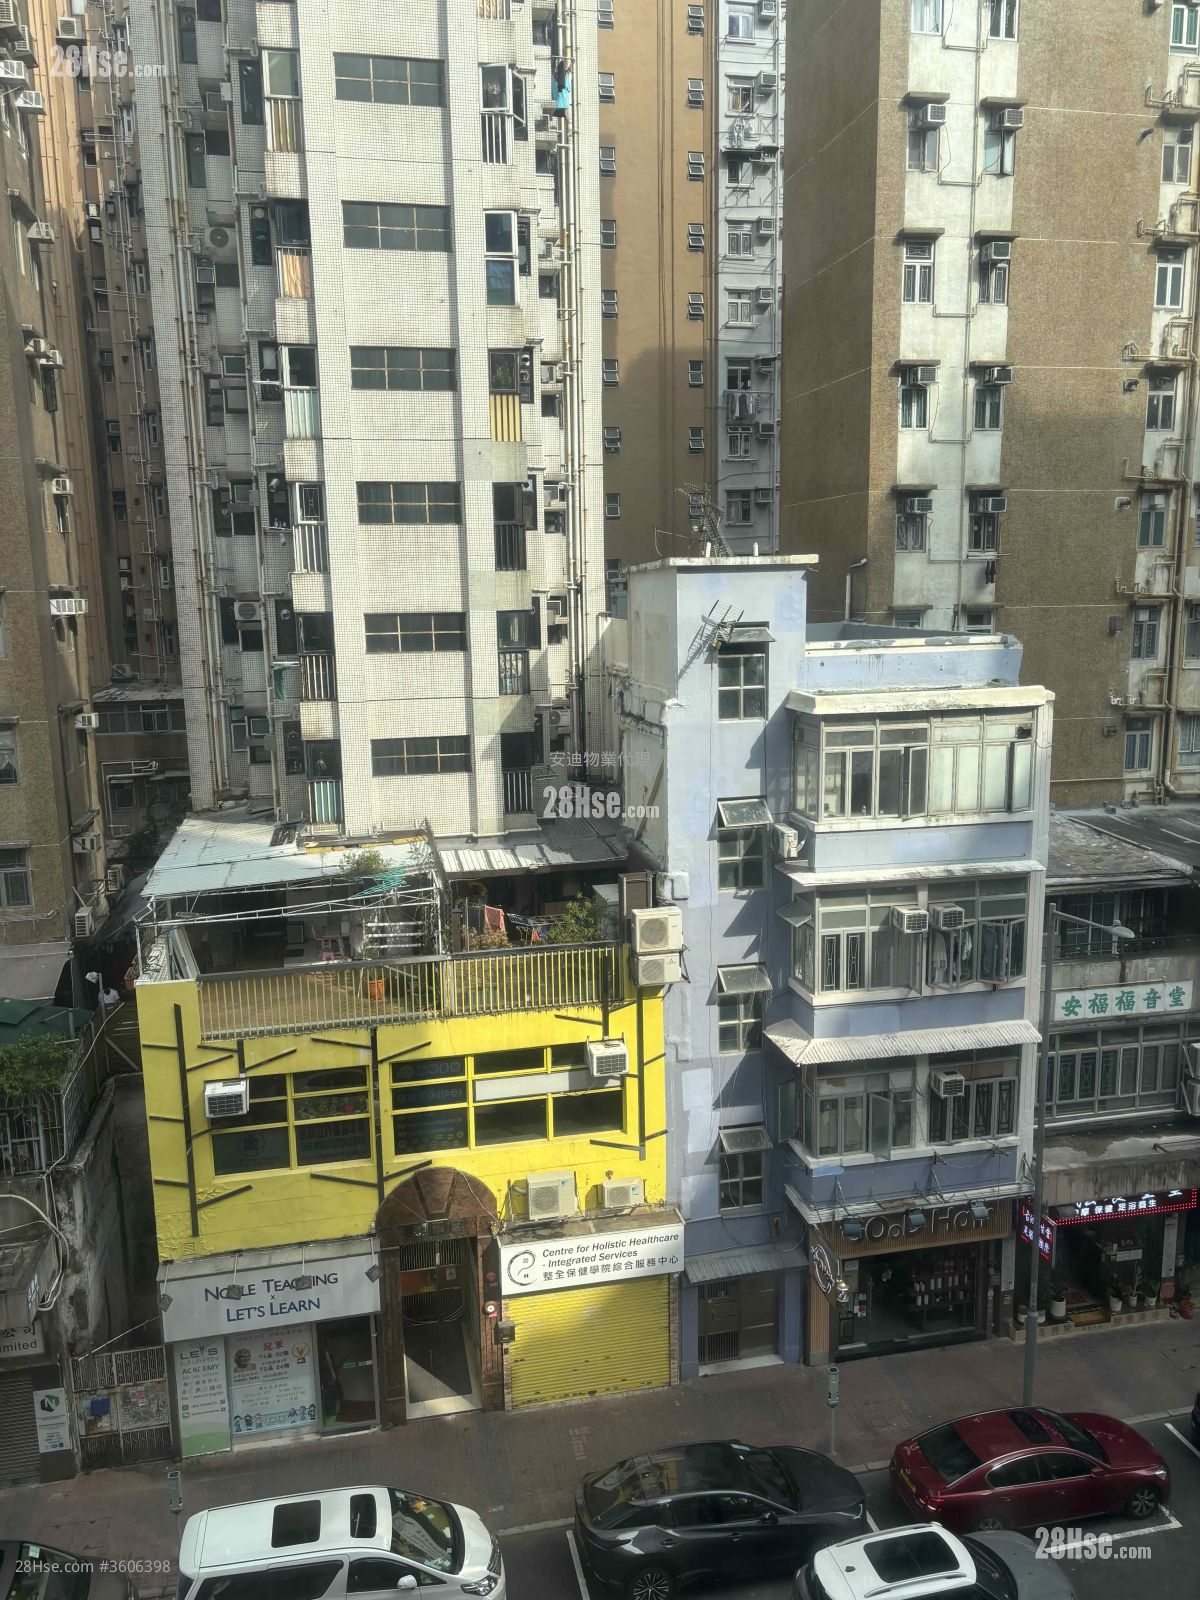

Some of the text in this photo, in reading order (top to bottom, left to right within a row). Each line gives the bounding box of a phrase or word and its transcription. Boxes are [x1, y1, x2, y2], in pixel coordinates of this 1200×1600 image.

[1061, 985, 1186, 1017] 安福福音堂
[542, 1233, 680, 1258] Centre for Holistic Healthcare
[542, 1255, 680, 1282] 整全保健學院綜合服務中心
[548, 1255, 597, 1269] Integrated
[598, 1250, 638, 1261] Services
[205, 1273, 338, 1302] NOLE TEACING
[226, 1297, 321, 1322] LET'S LEARN
